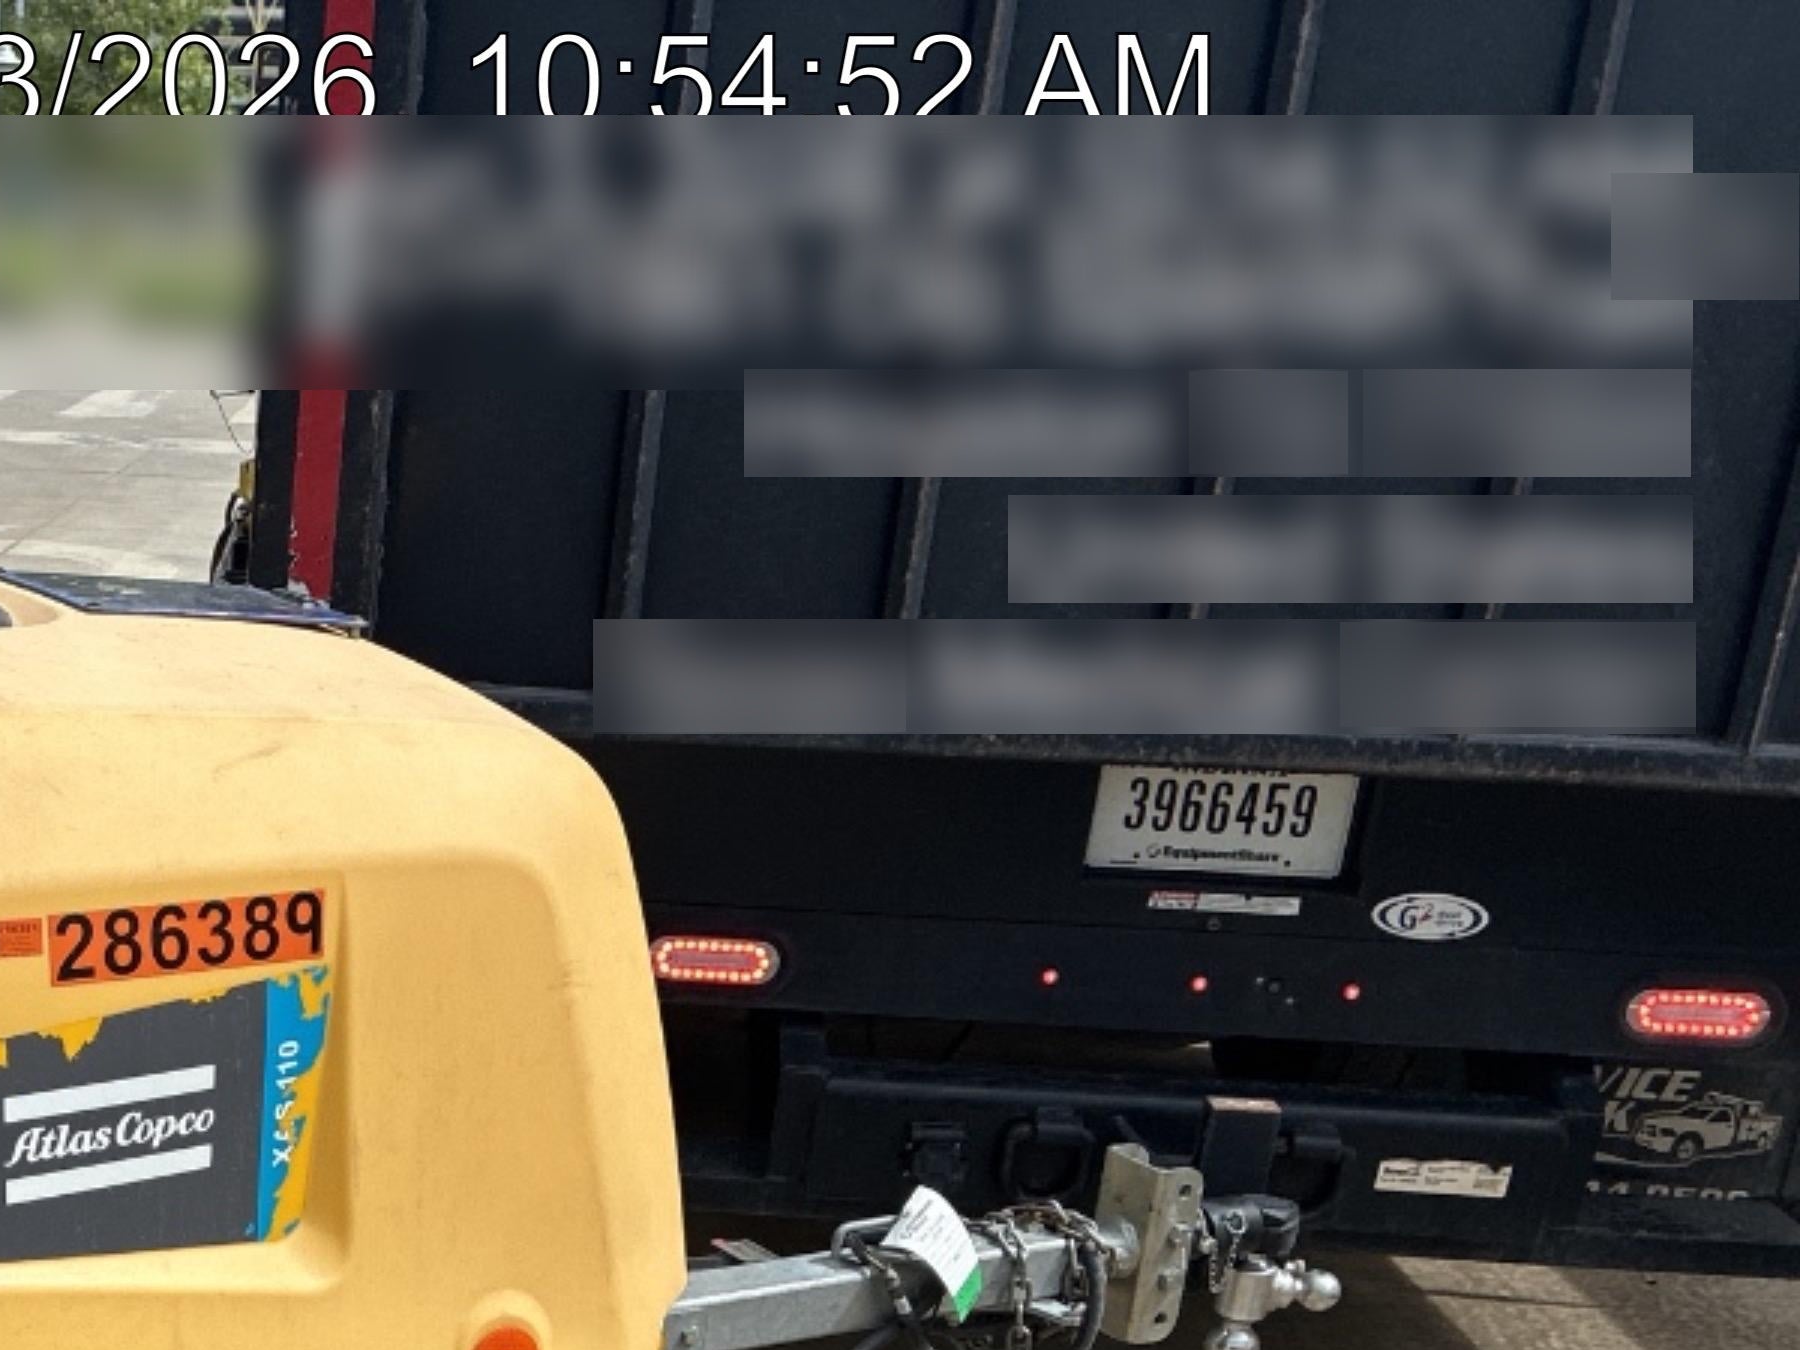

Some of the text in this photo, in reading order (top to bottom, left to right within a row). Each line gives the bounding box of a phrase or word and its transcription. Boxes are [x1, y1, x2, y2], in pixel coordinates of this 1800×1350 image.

[1123, 776, 1319, 837] 3966459
[55, 891, 323, 982] 286389
[3, 1107, 216, 1169] Atlas Copco
